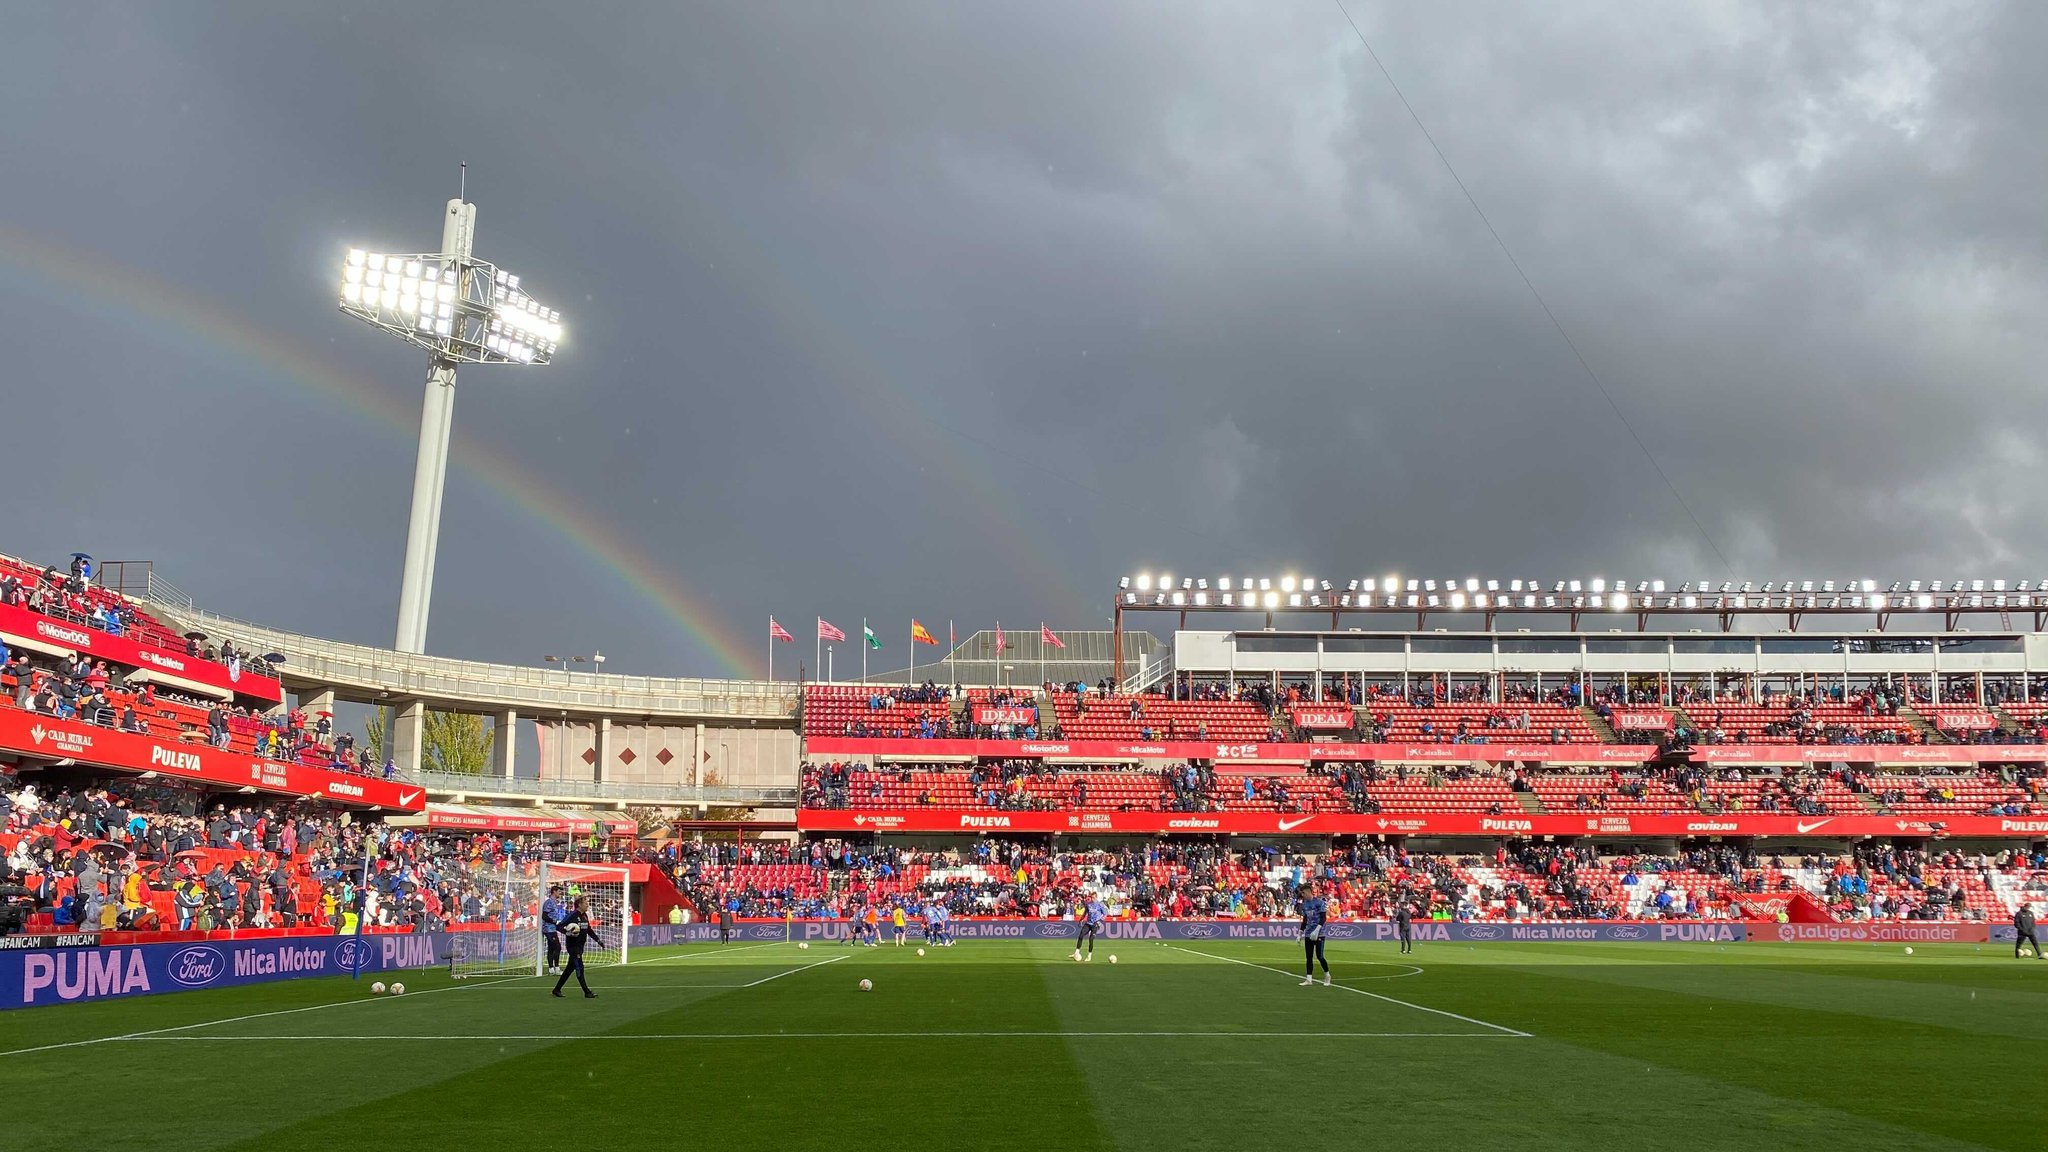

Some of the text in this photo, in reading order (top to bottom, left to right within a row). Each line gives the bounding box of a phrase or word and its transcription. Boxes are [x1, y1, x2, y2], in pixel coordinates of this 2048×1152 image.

[982, 710, 1028, 721] IDEAL
[1301, 714, 1347, 724] IDEAL
[1621, 715, 1667, 725] IDEAL
[1944, 715, 1991, 725] IDEAL
[47, 730, 93, 746] CAJA RURAL
[56, 742, 83, 753] GRANADA
[1029, 744, 1070, 753] MotorDOS
[1418, 748, 1453, 757] CaixaBank
[1515, 748, 1550, 757] CaixaBank
[151, 745, 201, 771] PULEVA
[440, 815, 462, 824] CERVEZAS
[463, 817, 487, 826] ALHAMBRA
[505, 819, 529, 827] CERVEZAS
[530, 820, 556, 828] ALHAMBRA
[961, 815, 1011, 827] PULEVA
[1083, 814, 1111, 822] CERVEZAS
[1482, 818, 1532, 830] PULEVA
[1601, 817, 1629, 825] CERVEZAS
[1081, 821, 1113, 829] ALHAMBRA
[1600, 824, 1631, 832] ALHAMBRA
[2002, 820, 2048, 832] PULEVA
[757, 924, 783, 938] Ford
[980, 924, 1026, 937] Motor
[1042, 924, 1067, 936] Ford
[1187, 923, 1213, 937] Ford
[1229, 925, 1266, 937] Mica
[1328, 925, 1354, 938] Ford
[1469, 926, 1496, 938] Ford
[1512, 926, 1598, 939] Mica Motor
[1613, 925, 1641, 938] Ford
[1661, 924, 1735, 941] PUMA
[1798, 925, 1958, 941] LaLiga Santander
[56, 935, 95, 946] #FANCAM
[382, 935, 435, 968] PUMA
[180, 951, 214, 979] Ford
[234, 947, 326, 977] Mica Motor
[24, 948, 150, 1003] PUMA
